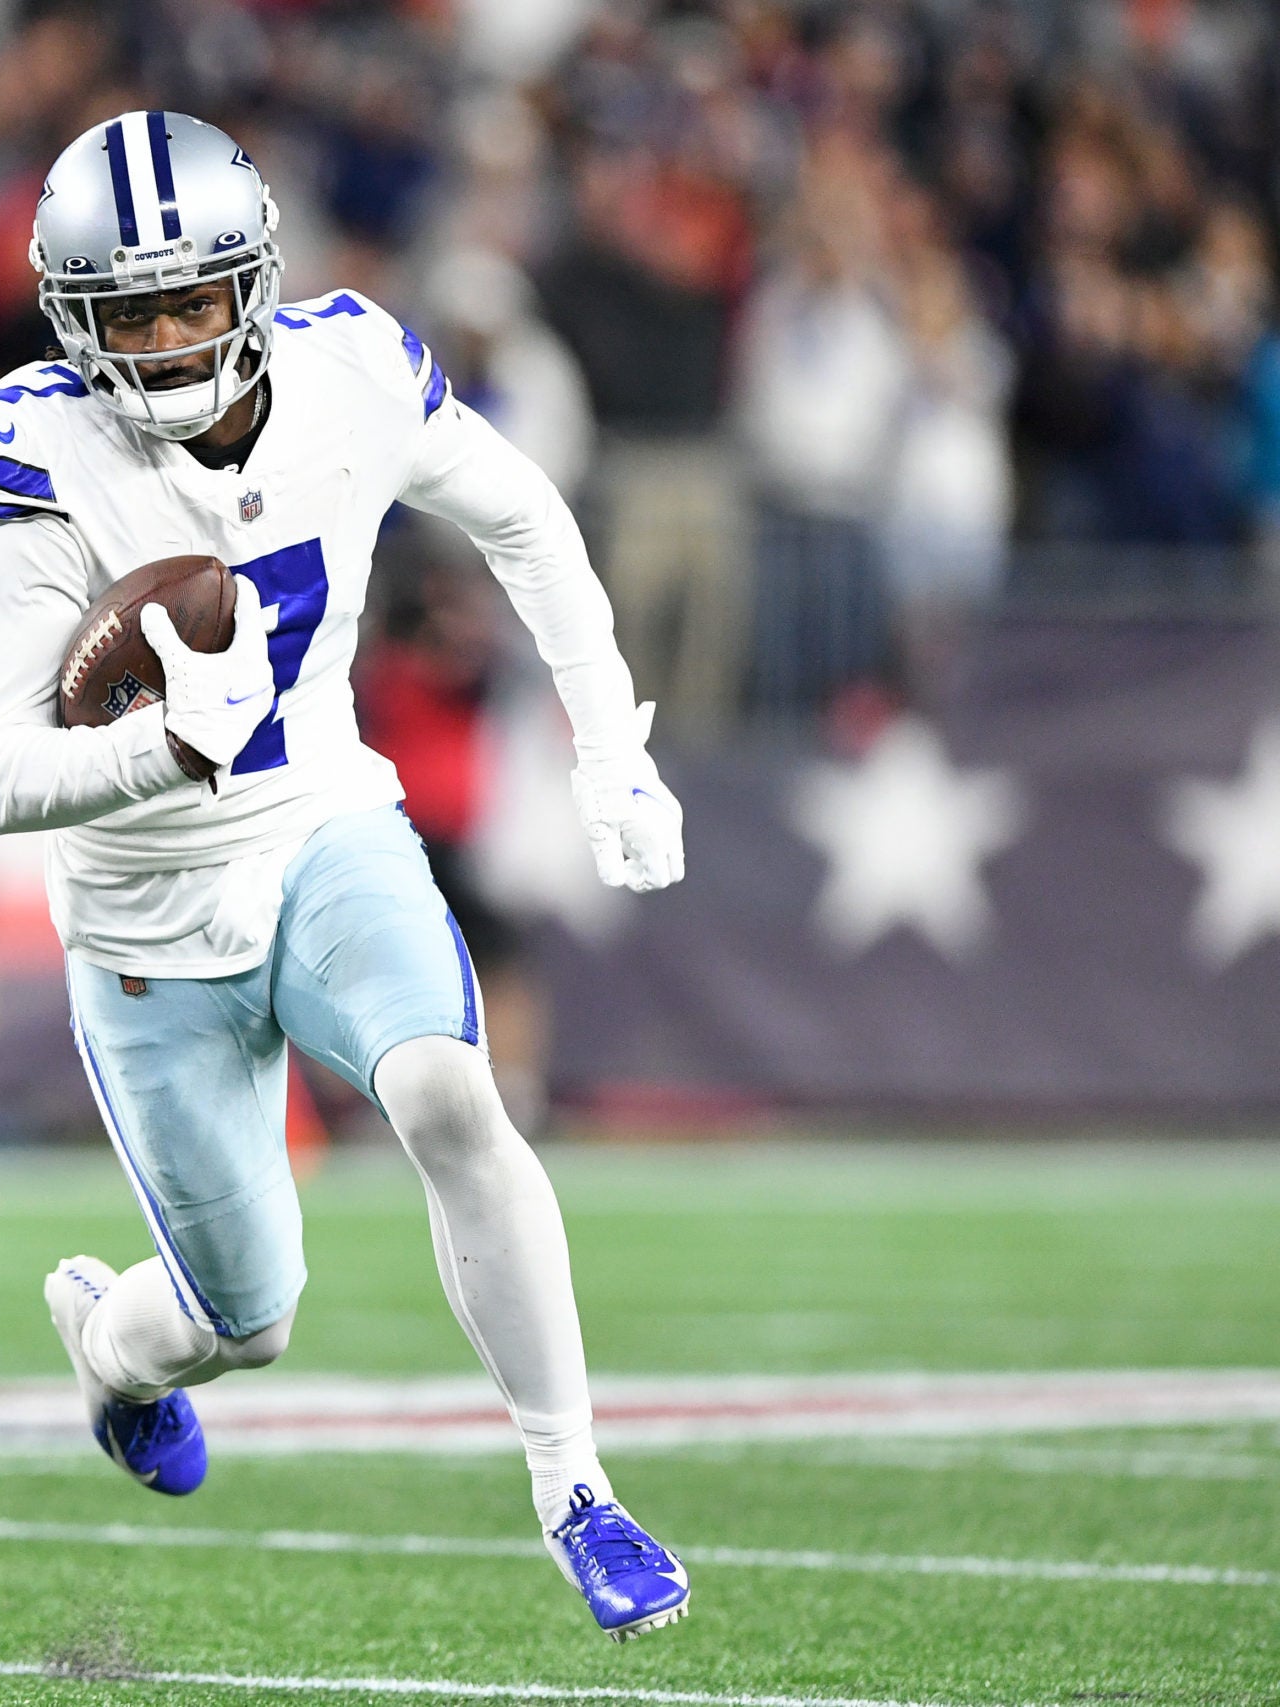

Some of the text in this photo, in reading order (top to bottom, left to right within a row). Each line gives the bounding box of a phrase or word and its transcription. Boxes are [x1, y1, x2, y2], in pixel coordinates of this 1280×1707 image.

[134, 248, 175, 261] COWBOYS
[243, 502, 261, 519] NFL
[225, 536, 329, 777] 7
